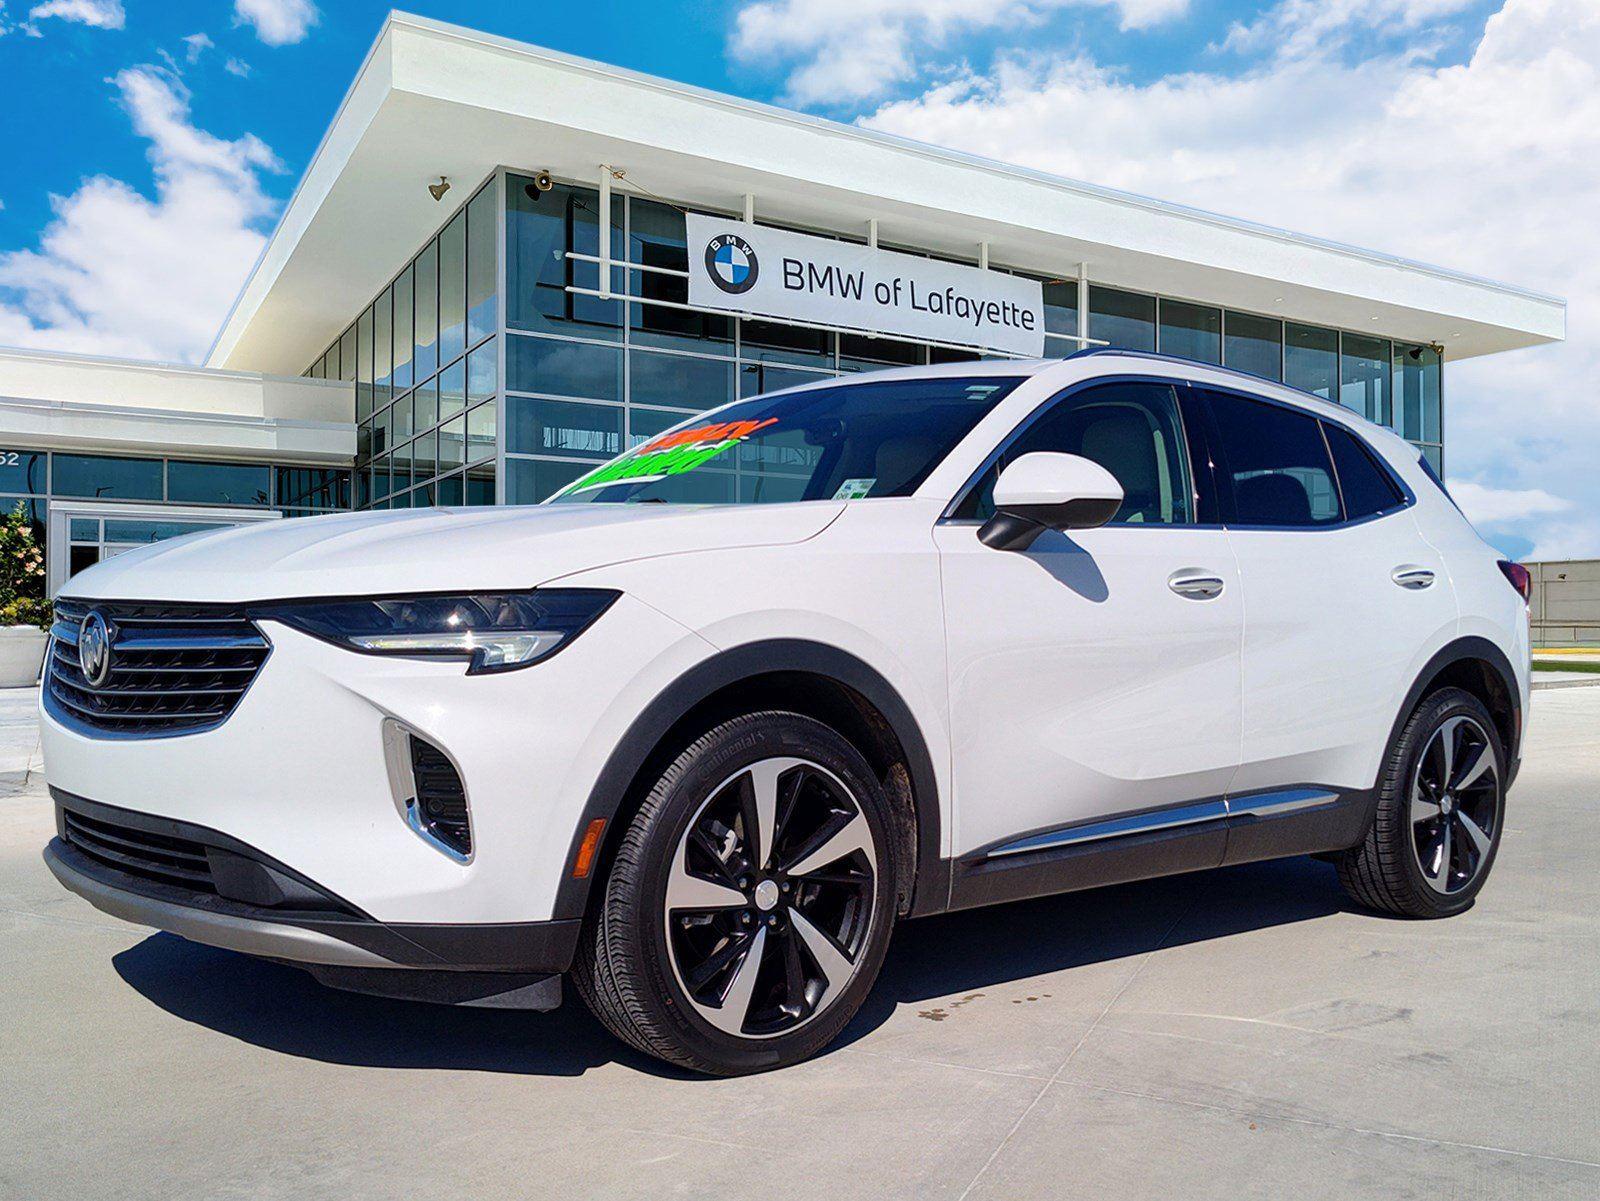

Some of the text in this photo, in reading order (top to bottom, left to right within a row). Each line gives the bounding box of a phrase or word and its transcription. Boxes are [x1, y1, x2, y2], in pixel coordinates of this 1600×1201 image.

[710, 235, 752, 255] BMW
[783, 258, 1035, 330] BMW of Lafayette
